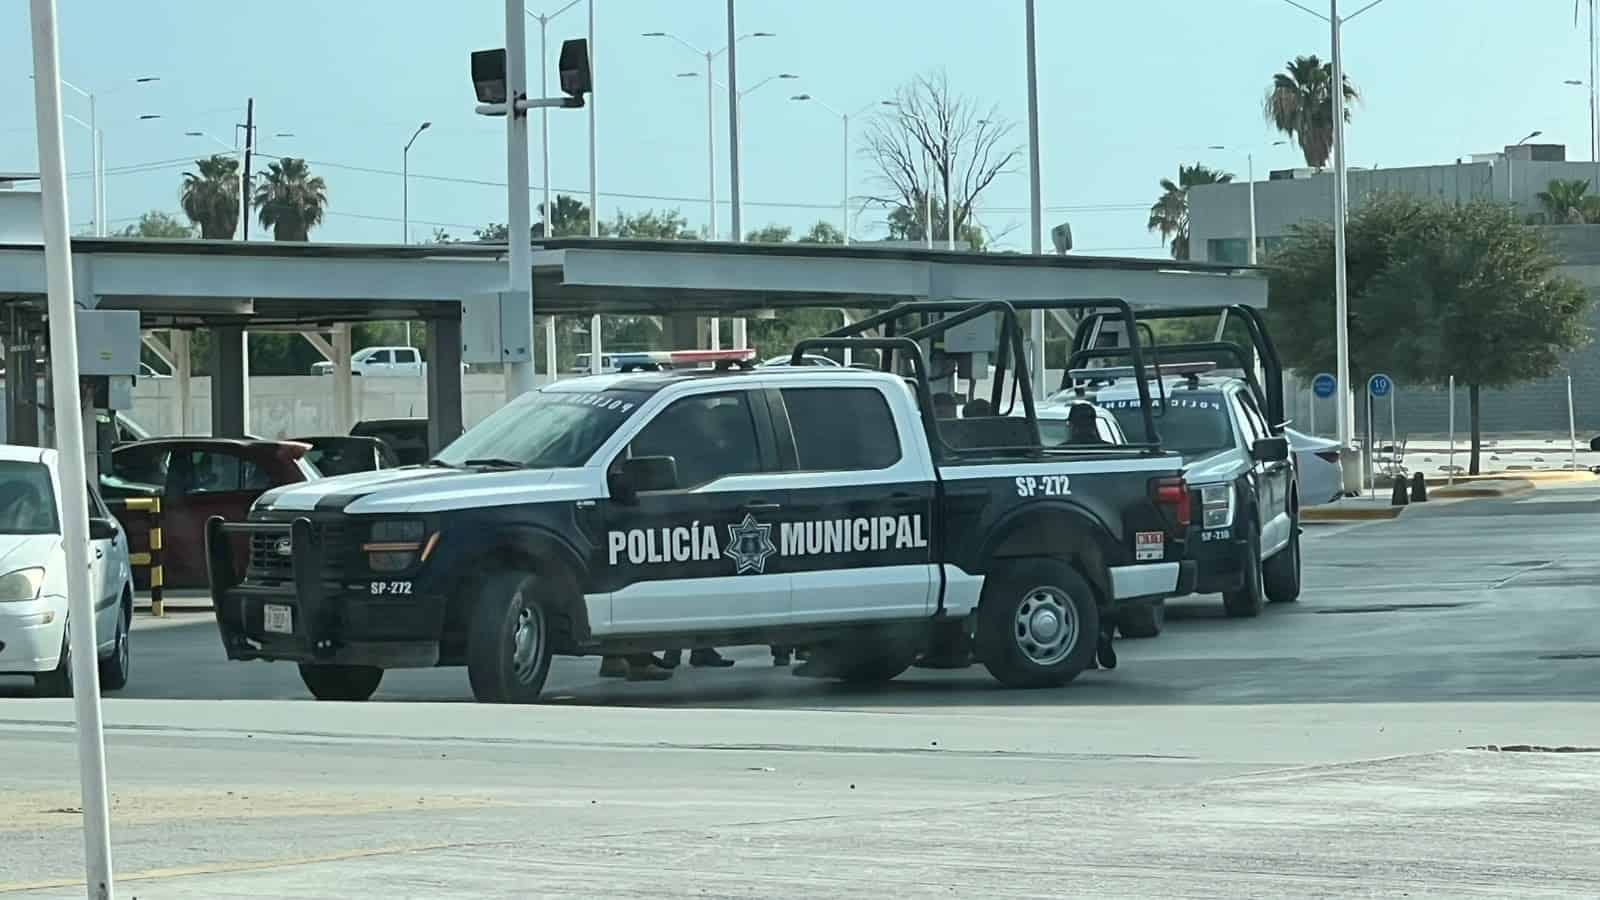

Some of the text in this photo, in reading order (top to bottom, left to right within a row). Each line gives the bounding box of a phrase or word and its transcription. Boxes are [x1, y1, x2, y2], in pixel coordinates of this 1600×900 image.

[1016, 475, 1072, 496] SP-272
[608, 514, 927, 565] POLICÍA MUNICIPAL
[371, 582, 412, 594] SP-272
